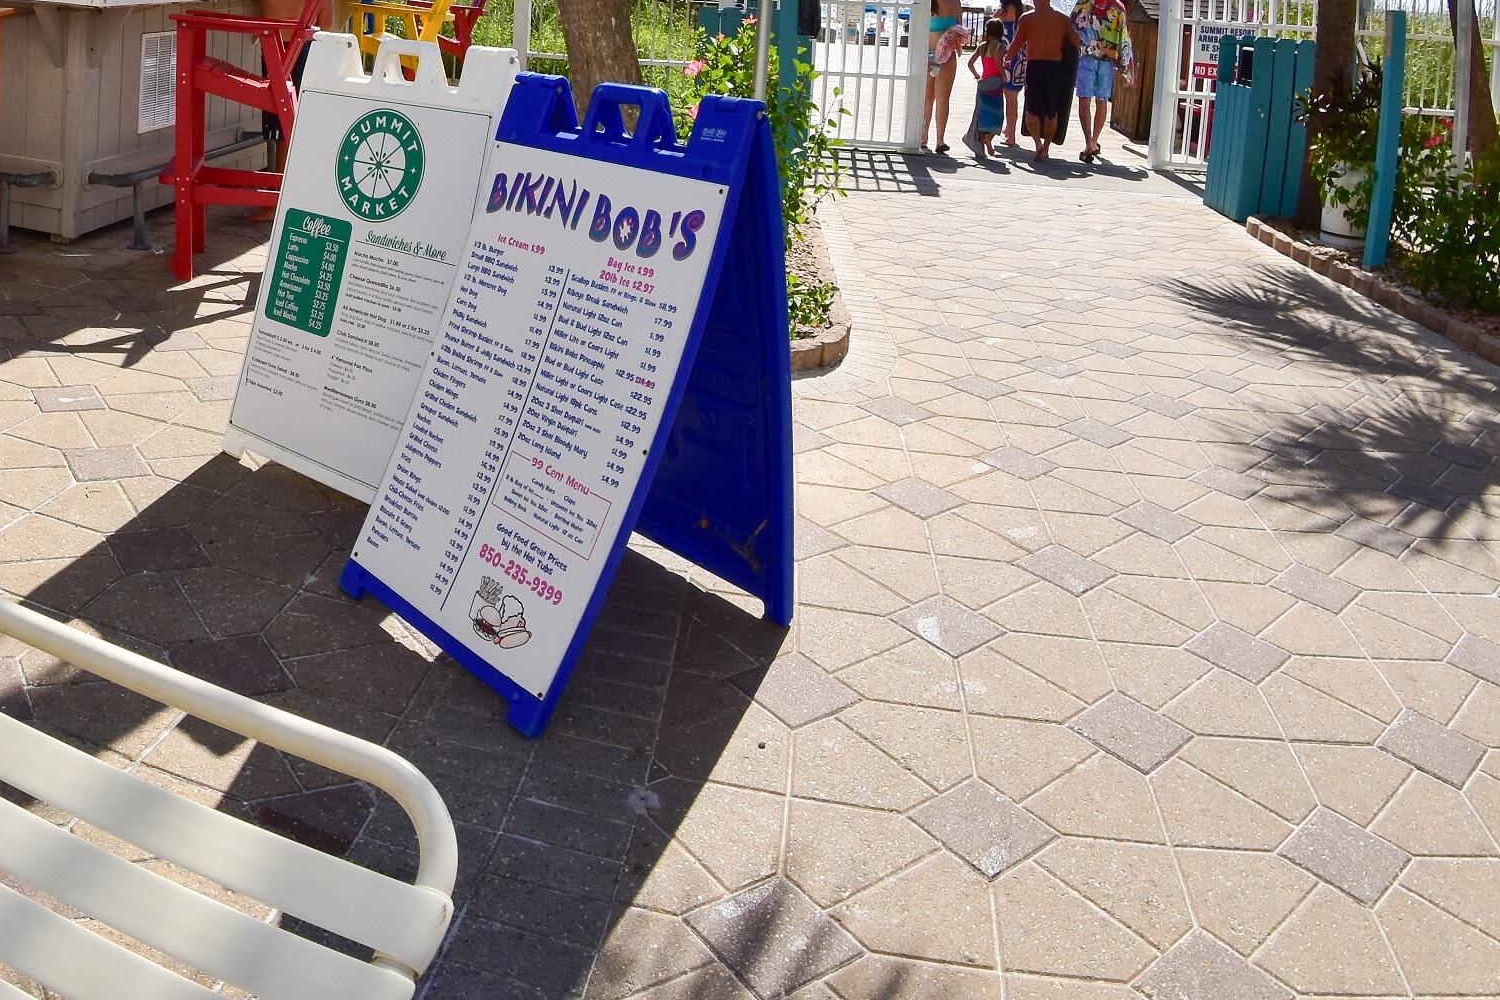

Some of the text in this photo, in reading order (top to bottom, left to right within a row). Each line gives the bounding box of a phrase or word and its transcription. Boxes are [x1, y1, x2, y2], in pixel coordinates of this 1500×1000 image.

[1201, 26, 1256, 37] SUMMIT RESORT
[1195, 67, 1205, 76] NO
[351, 117, 418, 152] SUMMIT
[342, 177, 409, 216] MARKET
[302, 216, 332, 238] Coffee
[486, 172, 705, 261] BIKINI BOB'S
[287, 242, 336, 262] Latte $4.00
[289, 232, 339, 252] Espresso $3.50
[365, 230, 446, 261] Sandwiches & More
[498, 234, 545, 255] Ice Cream $.99
[283, 261, 332, 282] Mocha $4.25
[286, 251, 334, 272] Cappuccino $4.00
[471, 251, 560, 286] Small BBQ Sandwich $3.99
[607, 257, 654, 278] Bag Ice $.99
[279, 280, 328, 301] Americano $3.25
[281, 270, 330, 291] Hot Chocolate $3.50
[349, 274, 365, 282] Cheese
[366, 278, 389, 289] Quesadilla
[571, 274, 677, 313] Scallop $11.99
[599, 270, 655, 294] 20lb Ice $2.97
[275, 298, 324, 320] Iced Coffee $3.25
[277, 289, 326, 310] Hot Tea $2.75
[349, 307, 369, 316] American
[377, 315, 386, 323] Dog
[456, 297, 542, 336] Corn Dog $1.49
[469, 288, 478, 299] Dog
[533, 313, 547, 323] $1.99
[566, 288, 673, 328] Ribeye Steak Sandwich $7.99
[273, 307, 322, 330] Iced Mocha $4.25
[562, 301, 664, 342] Natural Light 12oz Can $.99
[554, 328, 569, 339] Miller
[569, 334, 579, 344] Lite
[587, 341, 604, 353] Coors
[604, 348, 619, 359] Light
[640, 362, 656, 373] $1.99
[558, 315, 570, 325] Bud
[575, 321, 588, 332] Bud
[587, 326, 602, 337] Light
[603, 331, 615, 341] 12oz
[616, 336, 628, 346] Can
[645, 347, 661, 358] $1.99
[549, 341, 635, 382] Bikini Bobs Pineapple $12.95
[540, 369, 555, 380] Miller
[555, 375, 569, 387] Light
[577, 385, 593, 397] Coors
[593, 392, 608, 404] Light
[609, 399, 624, 411] Case
[625, 406, 647, 420] $22.95
[544, 355, 556, 366] Bud
[563, 363, 575, 374] Bud
[575, 368, 589, 380] Light
[590, 374, 604, 386] Case
[630, 392, 652, 405] $22.95
[526, 407, 627, 459] 20oz Virgin Daiquiri $1.99
[531, 396, 545, 407] 20oz
[545, 402, 550, 410] 3
[550, 405, 563, 416] Shot
[615, 435, 634, 448] $4.99
[517, 432, 619, 488] 20oz Long Island $4.99
[532, 457, 590, 495] 99 Cent Menu
[397, 464, 476, 516] Onion Rings $1.99
[497, 523, 567, 572] Good Food Great Prices
[501, 537, 554, 575] by the Hot Tubs
[479, 543, 562, 605] 850-235-9399
